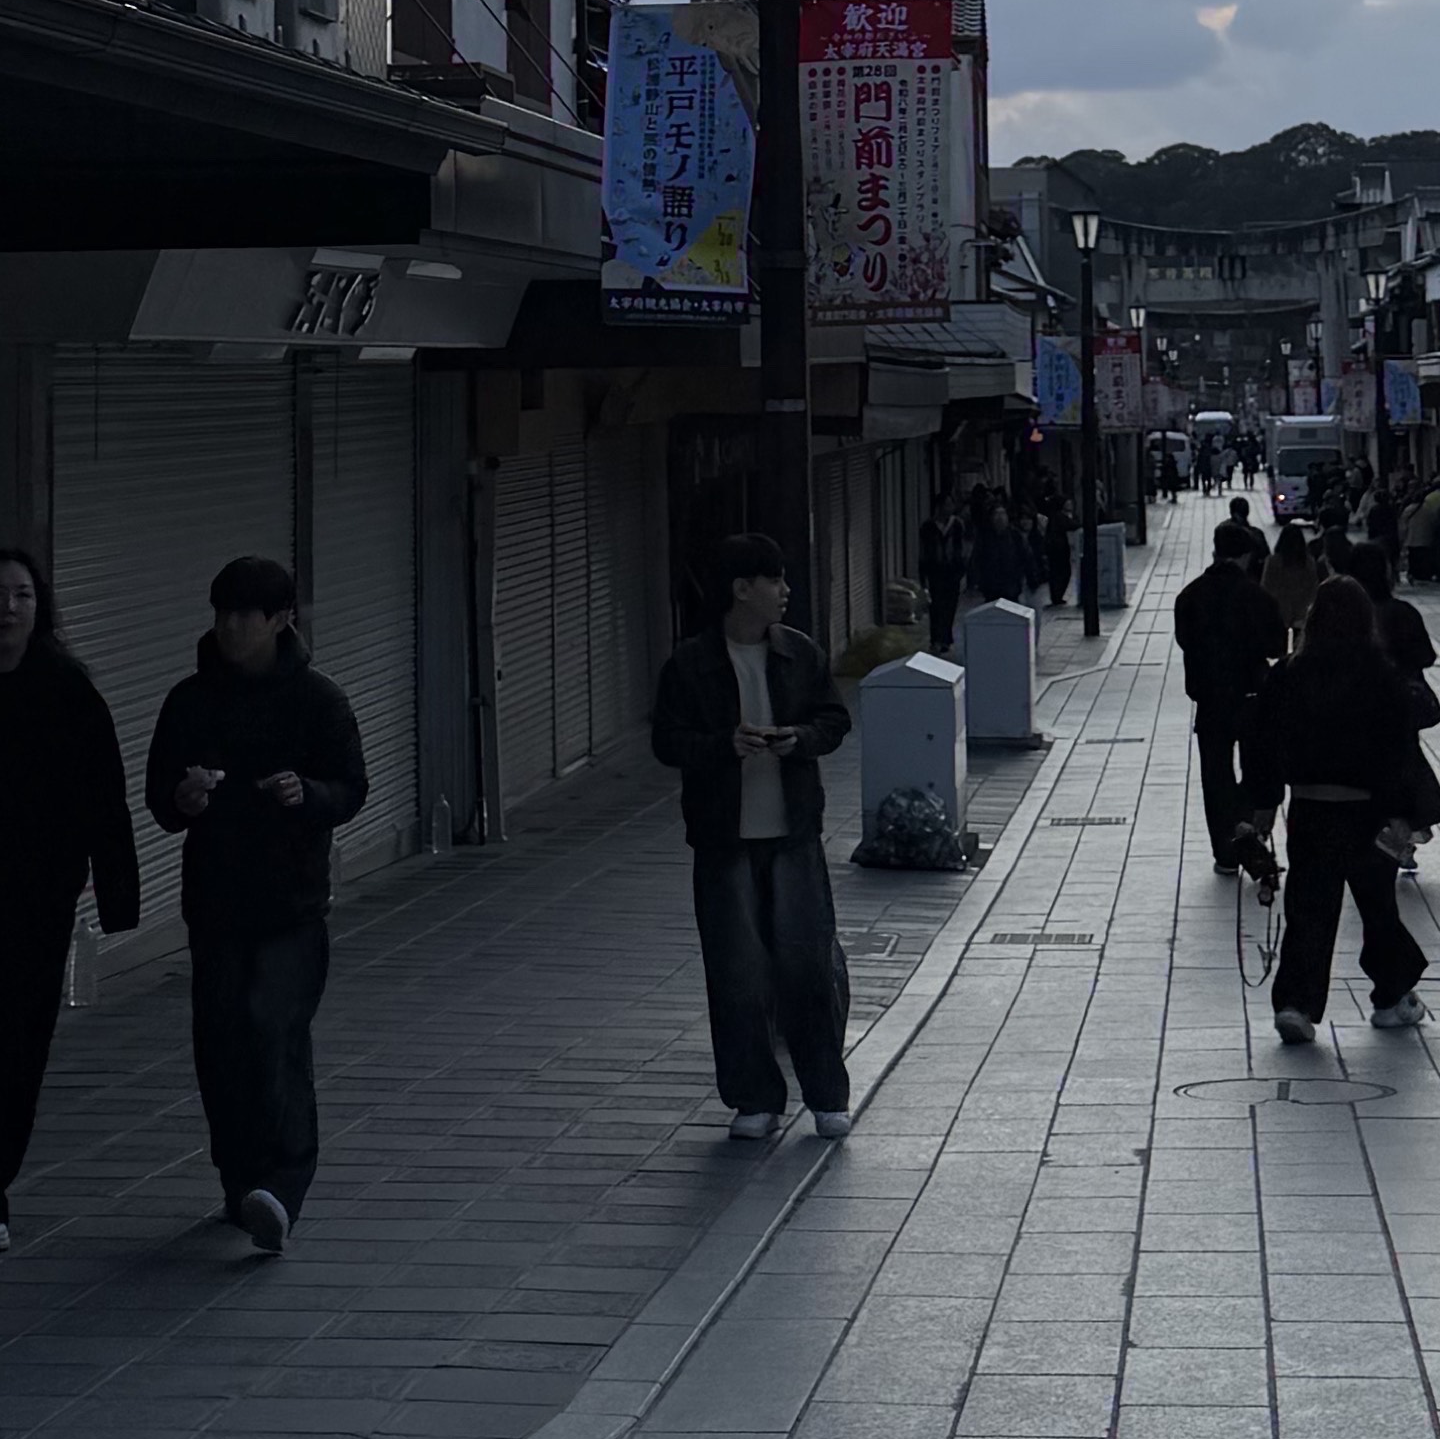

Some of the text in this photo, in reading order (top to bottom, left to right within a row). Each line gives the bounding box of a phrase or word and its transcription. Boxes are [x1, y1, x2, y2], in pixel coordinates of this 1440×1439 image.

[823, 41, 928, 60] 太宰府天満宮
[842, 3, 909, 31] 歓迎
[663, 56, 698, 251] 平戸モノ語り
[852, 81, 894, 292] 門前まつり
